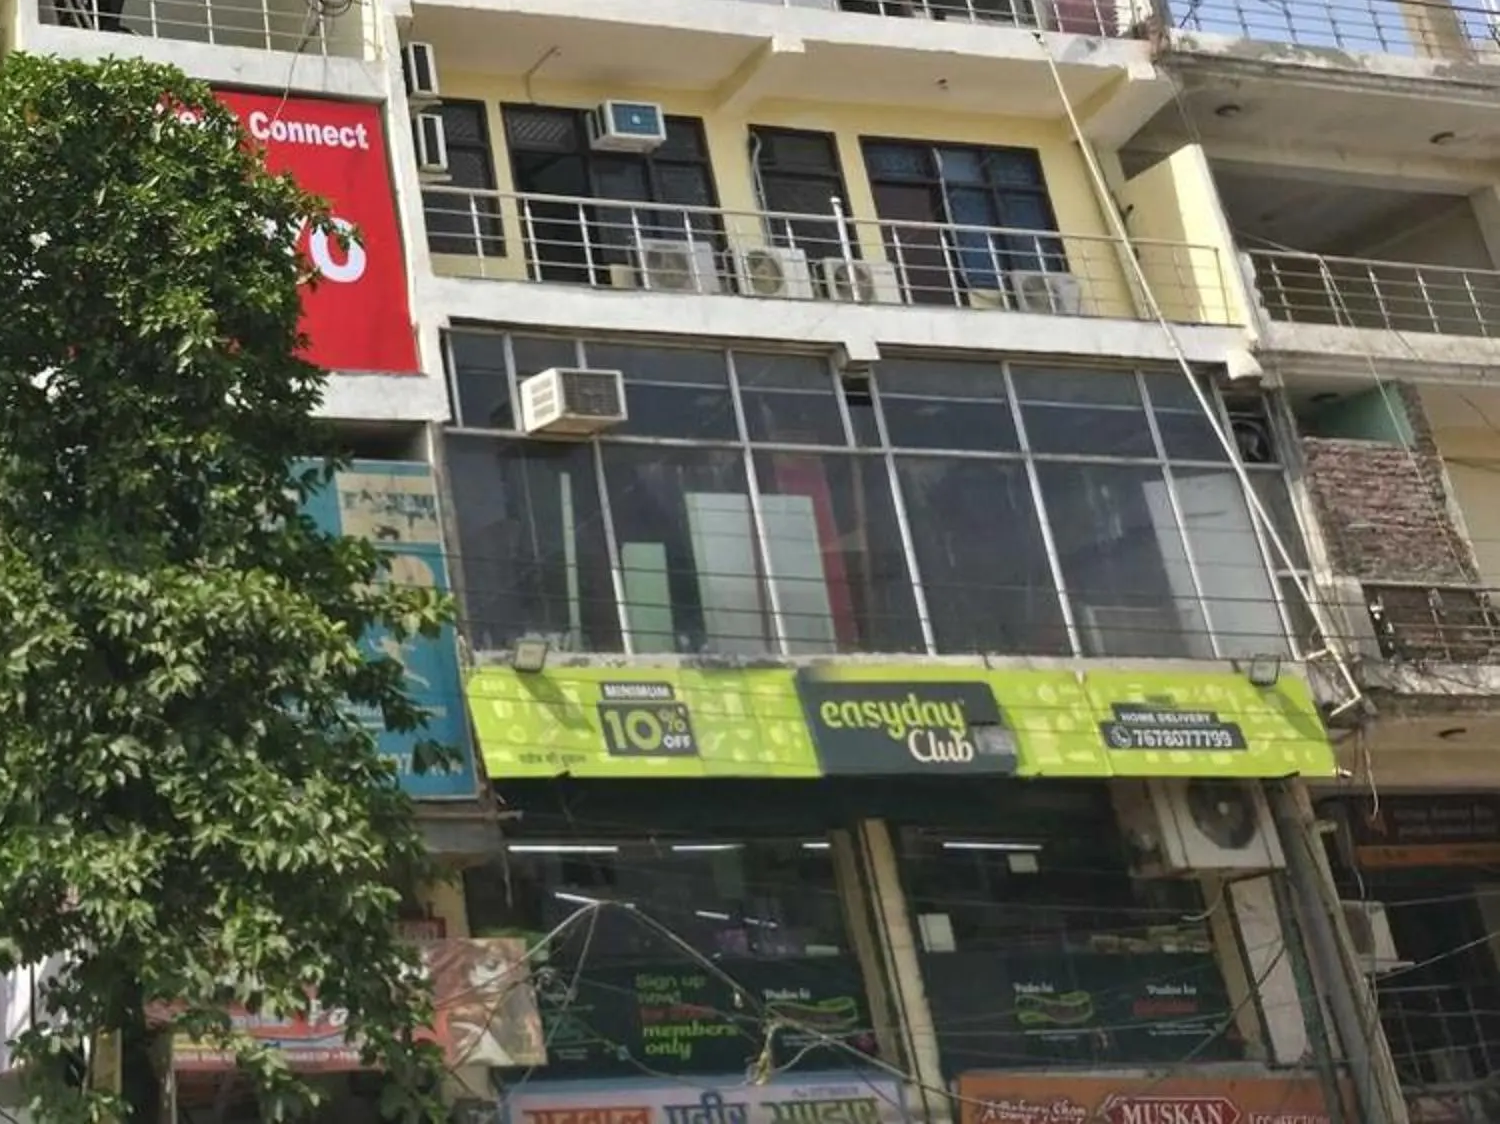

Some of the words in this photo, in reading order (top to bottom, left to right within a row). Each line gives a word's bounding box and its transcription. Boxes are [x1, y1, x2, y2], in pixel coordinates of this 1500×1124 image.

[250, 111, 369, 149] Connect
[603, 684, 671, 698] MINIMUM
[820, 693, 967, 740] easyday
[1120, 712, 1156, 723] HOME
[1157, 713, 1211, 724] DELIVERY
[663, 734, 692, 749] OFF
[908, 728, 974, 763] Club
[643, 1020, 739, 1038] members
[645, 1036, 692, 1060] only
[1122, 1102, 1224, 1124] MUSKAN
